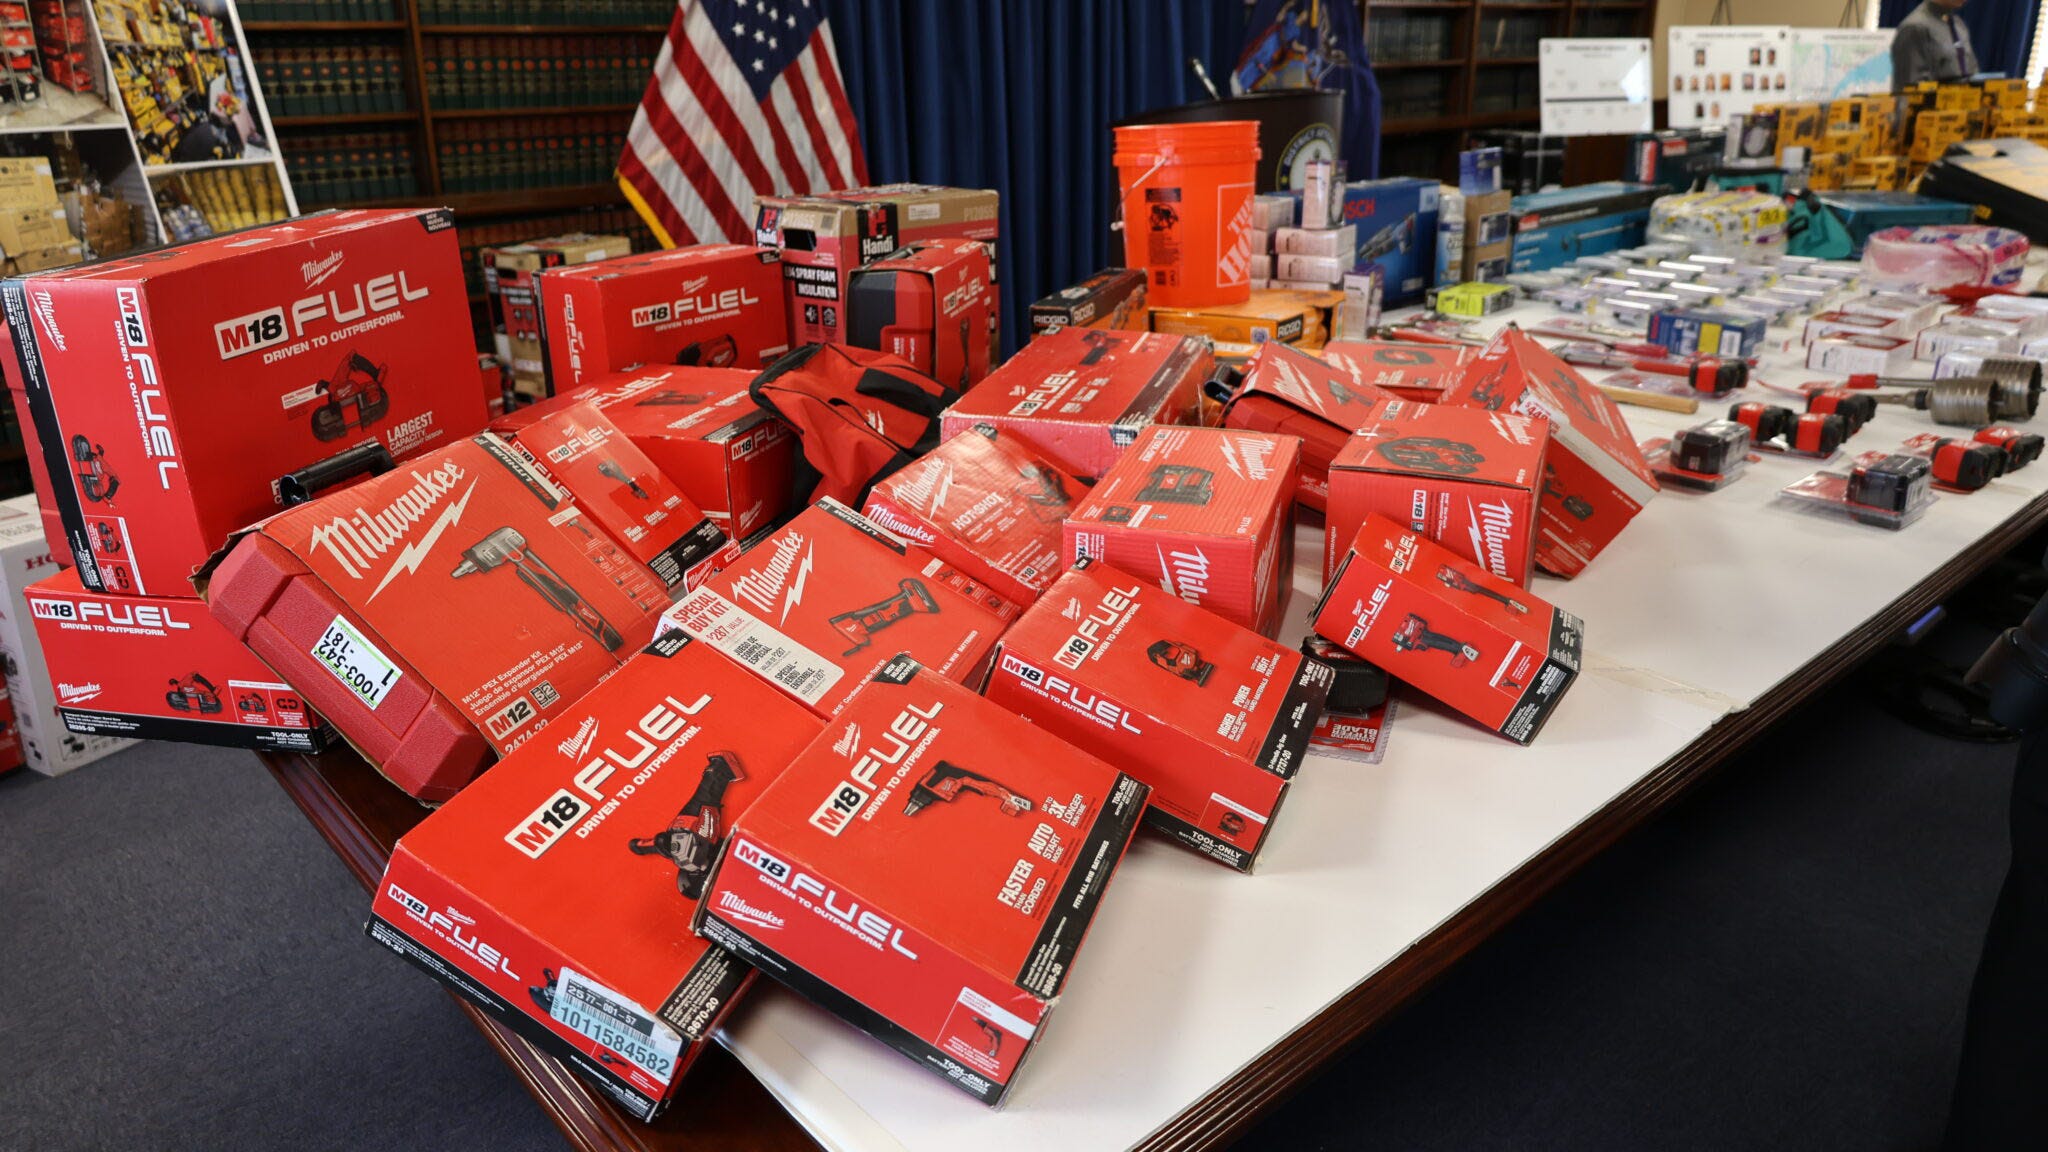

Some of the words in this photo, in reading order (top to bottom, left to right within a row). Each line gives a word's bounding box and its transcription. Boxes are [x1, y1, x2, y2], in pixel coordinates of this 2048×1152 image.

[863, 237, 894, 254] Handi
[301, 250, 344, 283] Milwaukee
[796, 266, 816, 282] SPRAY
[816, 267, 837, 283] FOAM
[34, 288, 68, 352] Milwaukee
[121, 291, 144, 344] M18
[221, 312, 283, 356] M18
[292, 271, 429, 337] FUEL
[635, 305, 668, 327] M18
[674, 287, 759, 319] FUEL
[1033, 315, 1069, 325] RIDGID
[1073, 303, 1095, 323] RIDGID
[114, 320, 130, 362] DRIVEN
[263, 341, 310, 365] DRIVEN
[312, 335, 328, 349] TO
[331, 310, 405, 342] OUTPERFORM.
[1277, 319, 1301, 337] RIDGID
[125, 363, 134, 381] TO
[128, 381, 153, 458] OUTPERFORM.
[132, 353, 179, 490] FUEL
[387, 411, 434, 443] LARGEST
[389, 429, 427, 452] CAPACITY
[514, 442, 534, 463] M18
[568, 425, 614, 453] FUEL
[893, 455, 946, 511] Milwaukee
[310, 457, 466, 580] Milwaukee
[1414, 492, 1423, 518] M18
[867, 503, 936, 544] Milwaukee
[731, 528, 805, 613] Milwaukee
[36, 602, 73, 619] M18
[79, 602, 190, 629] FUEL
[672, 592, 718, 625] SPECIAL
[687, 616, 709, 634] BUY
[709, 601, 730, 619] KIT
[1357, 579, 1392, 629] FUEL
[60, 622, 91, 632] DRIVEN
[92, 625, 105, 633] TO
[106, 625, 168, 637] OUTPERFORM.
[706, 625, 731, 642] $287
[1058, 638, 1089, 667] M18
[1078, 585, 1141, 643] FUEL
[1091, 640, 1110, 662] DRIVEN
[1107, 632, 1116, 643] TO
[1112, 603, 1142, 635] OUTPERFORM.
[318, 640, 380, 701] 1003-542
[483, 676, 498, 691] PEX
[499, 656, 530, 682] Expander
[529, 650, 542, 664] Kit
[503, 665, 536, 691] expansor
[537, 655, 549, 667] PEX
[56, 682, 102, 699] Milwaukee
[474, 691, 511, 716] Ensemble
[1004, 658, 1042, 682] M18
[1044, 676, 1142, 735] FUEL
[1020, 680, 1049, 697] DRIVEN
[1050, 694, 1061, 704] TO
[1061, 700, 1115, 730] OUTPERFORM.
[1232, 684, 1252, 708] POWER
[490, 701, 532, 735] M12
[1217, 712, 1237, 738] HIGHER
[557, 715, 597, 759] Milwaukee
[832, 722, 857, 757] Milwaukee
[513, 795, 582, 853] M18
[573, 693, 713, 802] FUEL
[575, 798, 621, 838] DRIVEN
[617, 783, 636, 804] TO
[633, 725, 702, 785] OUTPERFORM.
[816, 786, 861, 832] M18
[850, 701, 945, 791] FUEL
[861, 788, 892, 822] DRIVEN
[887, 776, 901, 789] TO
[896, 726, 942, 778] OUTPERFORM.
[1048, 800, 1068, 819] 3X
[1063, 793, 1084, 824] LONGER
[1027, 822, 1054, 855] AUTO
[1043, 833, 1062, 860] START
[1051, 846, 1065, 863] MODE
[1192, 830, 1242, 859] TOOL-ONLY
[997, 858, 1035, 907] FASTER
[1021, 877, 1048, 915] CORDED
[719, 890, 786, 927] Milwaukee
[738, 844, 787, 878] M18
[790, 872, 918, 961] FUEL
[758, 873, 797, 900] DRIVEN
[797, 895, 814, 909] TO
[813, 904, 884, 951] OUTPERFORM.
[1014, 893, 1027, 910] THAN
[390, 886, 427, 915] M18
[428, 911, 520, 981] FUEL
[405, 910, 433, 930] DRIVEN
[434, 927, 446, 938] TO
[445, 935, 498, 973] OUTPERFORM.
[1041, 962, 1064, 997] 2866-20
[687, 997, 720, 1036] 3670-20
[560, 1006, 670, 1076] 1011584582
[943, 1058, 991, 1088] TOOL-ONLY
